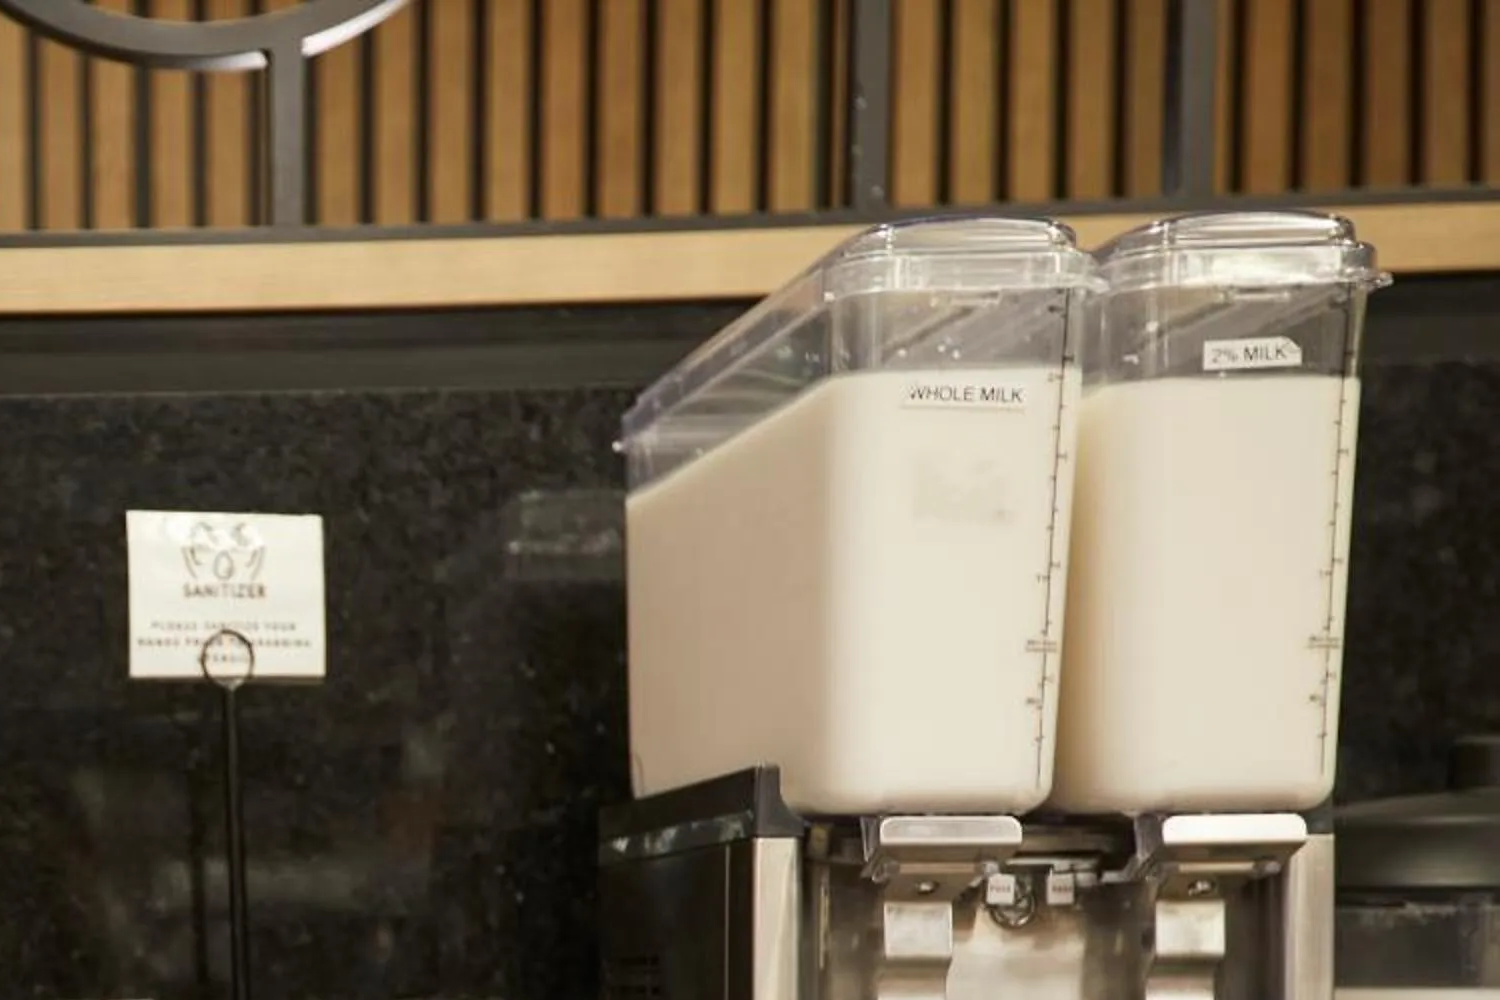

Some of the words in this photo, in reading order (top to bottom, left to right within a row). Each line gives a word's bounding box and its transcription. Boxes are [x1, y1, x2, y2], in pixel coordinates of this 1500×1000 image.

[1212, 347, 1239, 364] 2%
[1244, 344, 1287, 361] MILK
[908, 384, 974, 402] WHOLE
[980, 386, 1024, 403] MILK
[183, 582, 266, 599] SANITIZER
